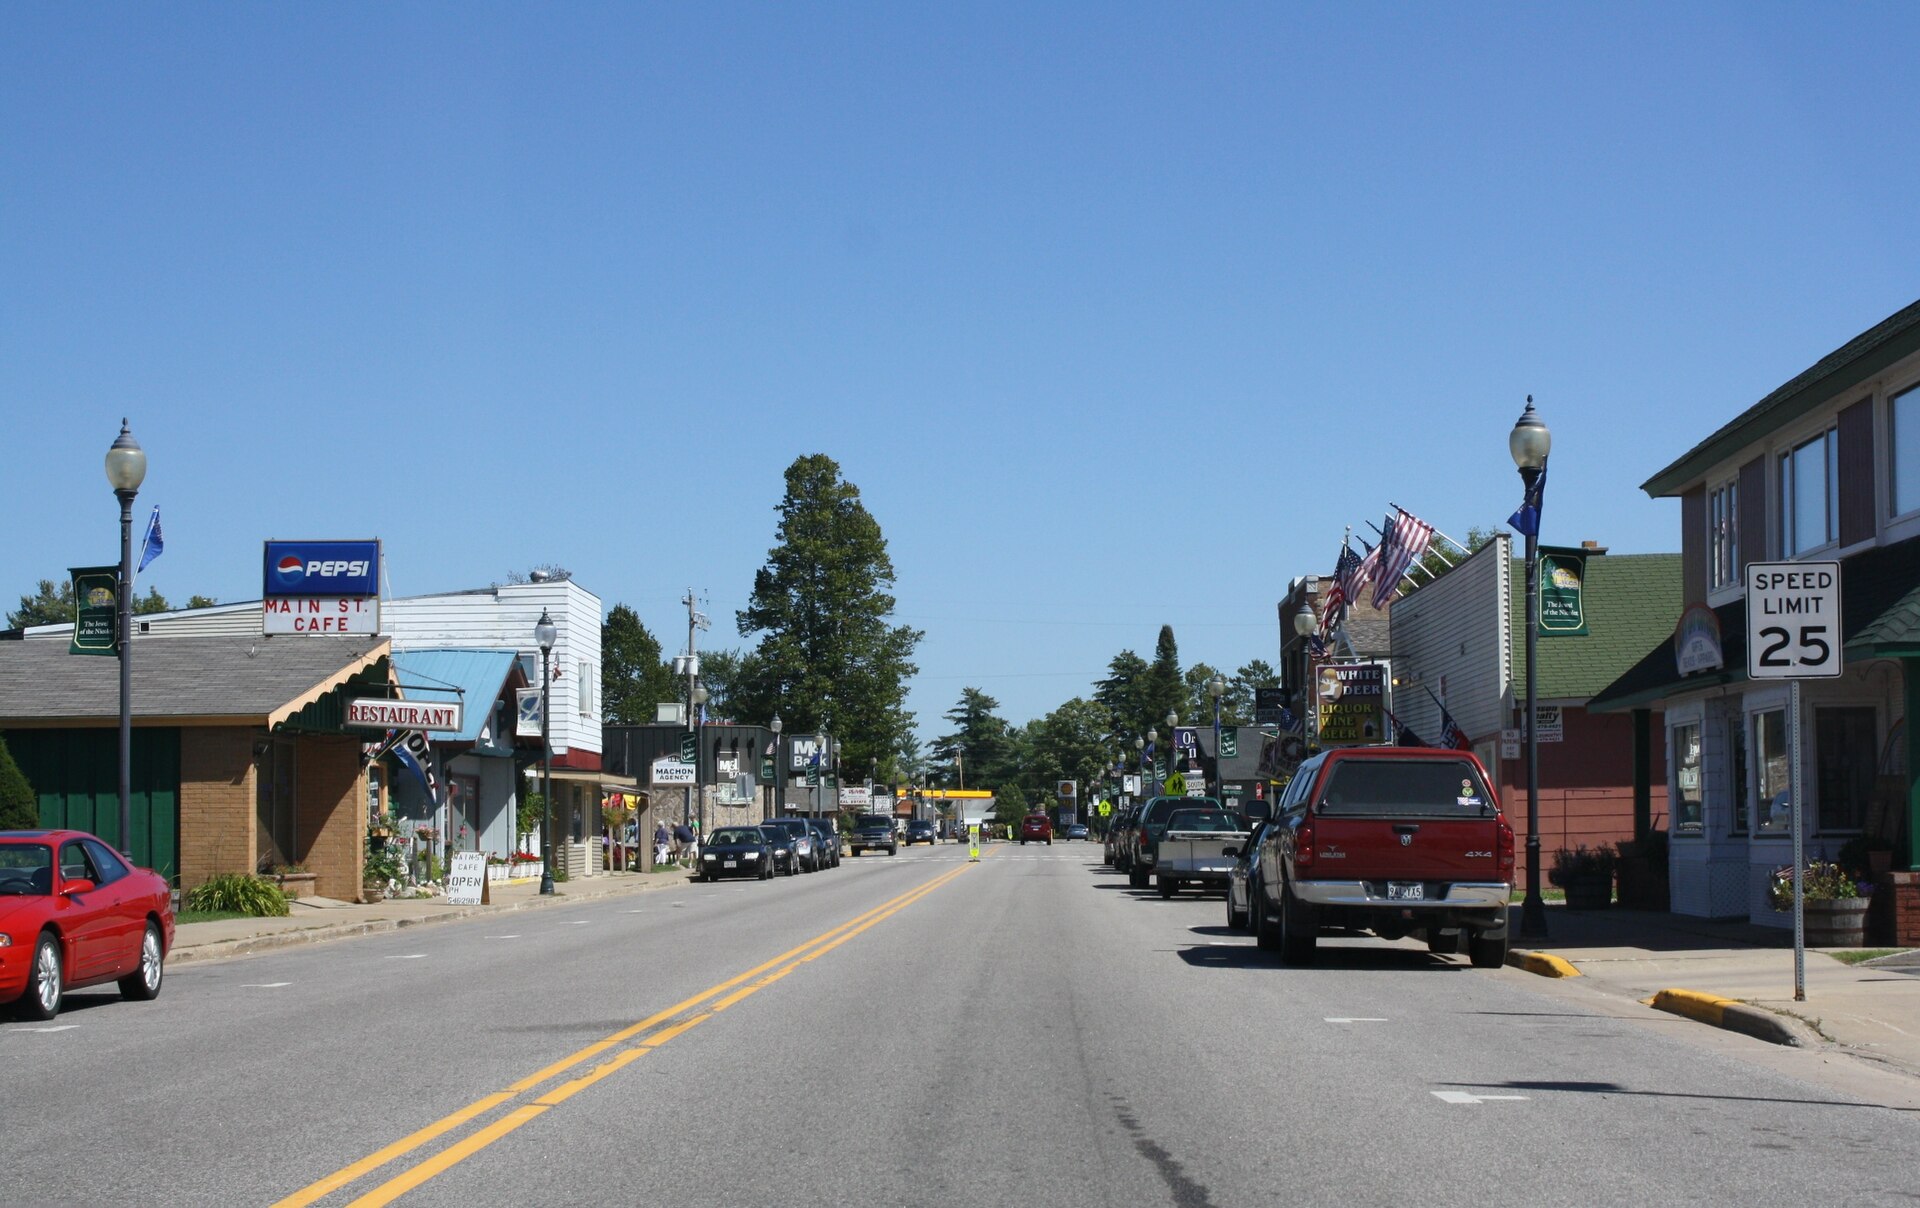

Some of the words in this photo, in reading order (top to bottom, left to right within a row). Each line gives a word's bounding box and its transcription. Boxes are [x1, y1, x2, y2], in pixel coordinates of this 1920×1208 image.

[305, 561, 370, 577] PEPSI
[1755, 572, 1832, 590] SPEED
[264, 599, 320, 614] MAIN
[338, 599, 368, 613] ST.
[1764, 597, 1824, 614] LIMIT
[294, 617, 348, 631] CAFE
[1759, 626, 1830, 666] 25
[1336, 669, 1380, 681] WHITE
[1343, 685, 1380, 695] DEER
[349, 704, 454, 726] RESTAURANT
[1321, 704, 1372, 714] LIQUOR
[1321, 717, 1355, 726] WINE
[1321, 729, 1357, 739] BEER
[793, 755, 827, 767] Bak
[1186, 781, 1205, 789] SOUTH
[457, 863, 478, 871] CAFE
[451, 876, 481, 887] OPEN
